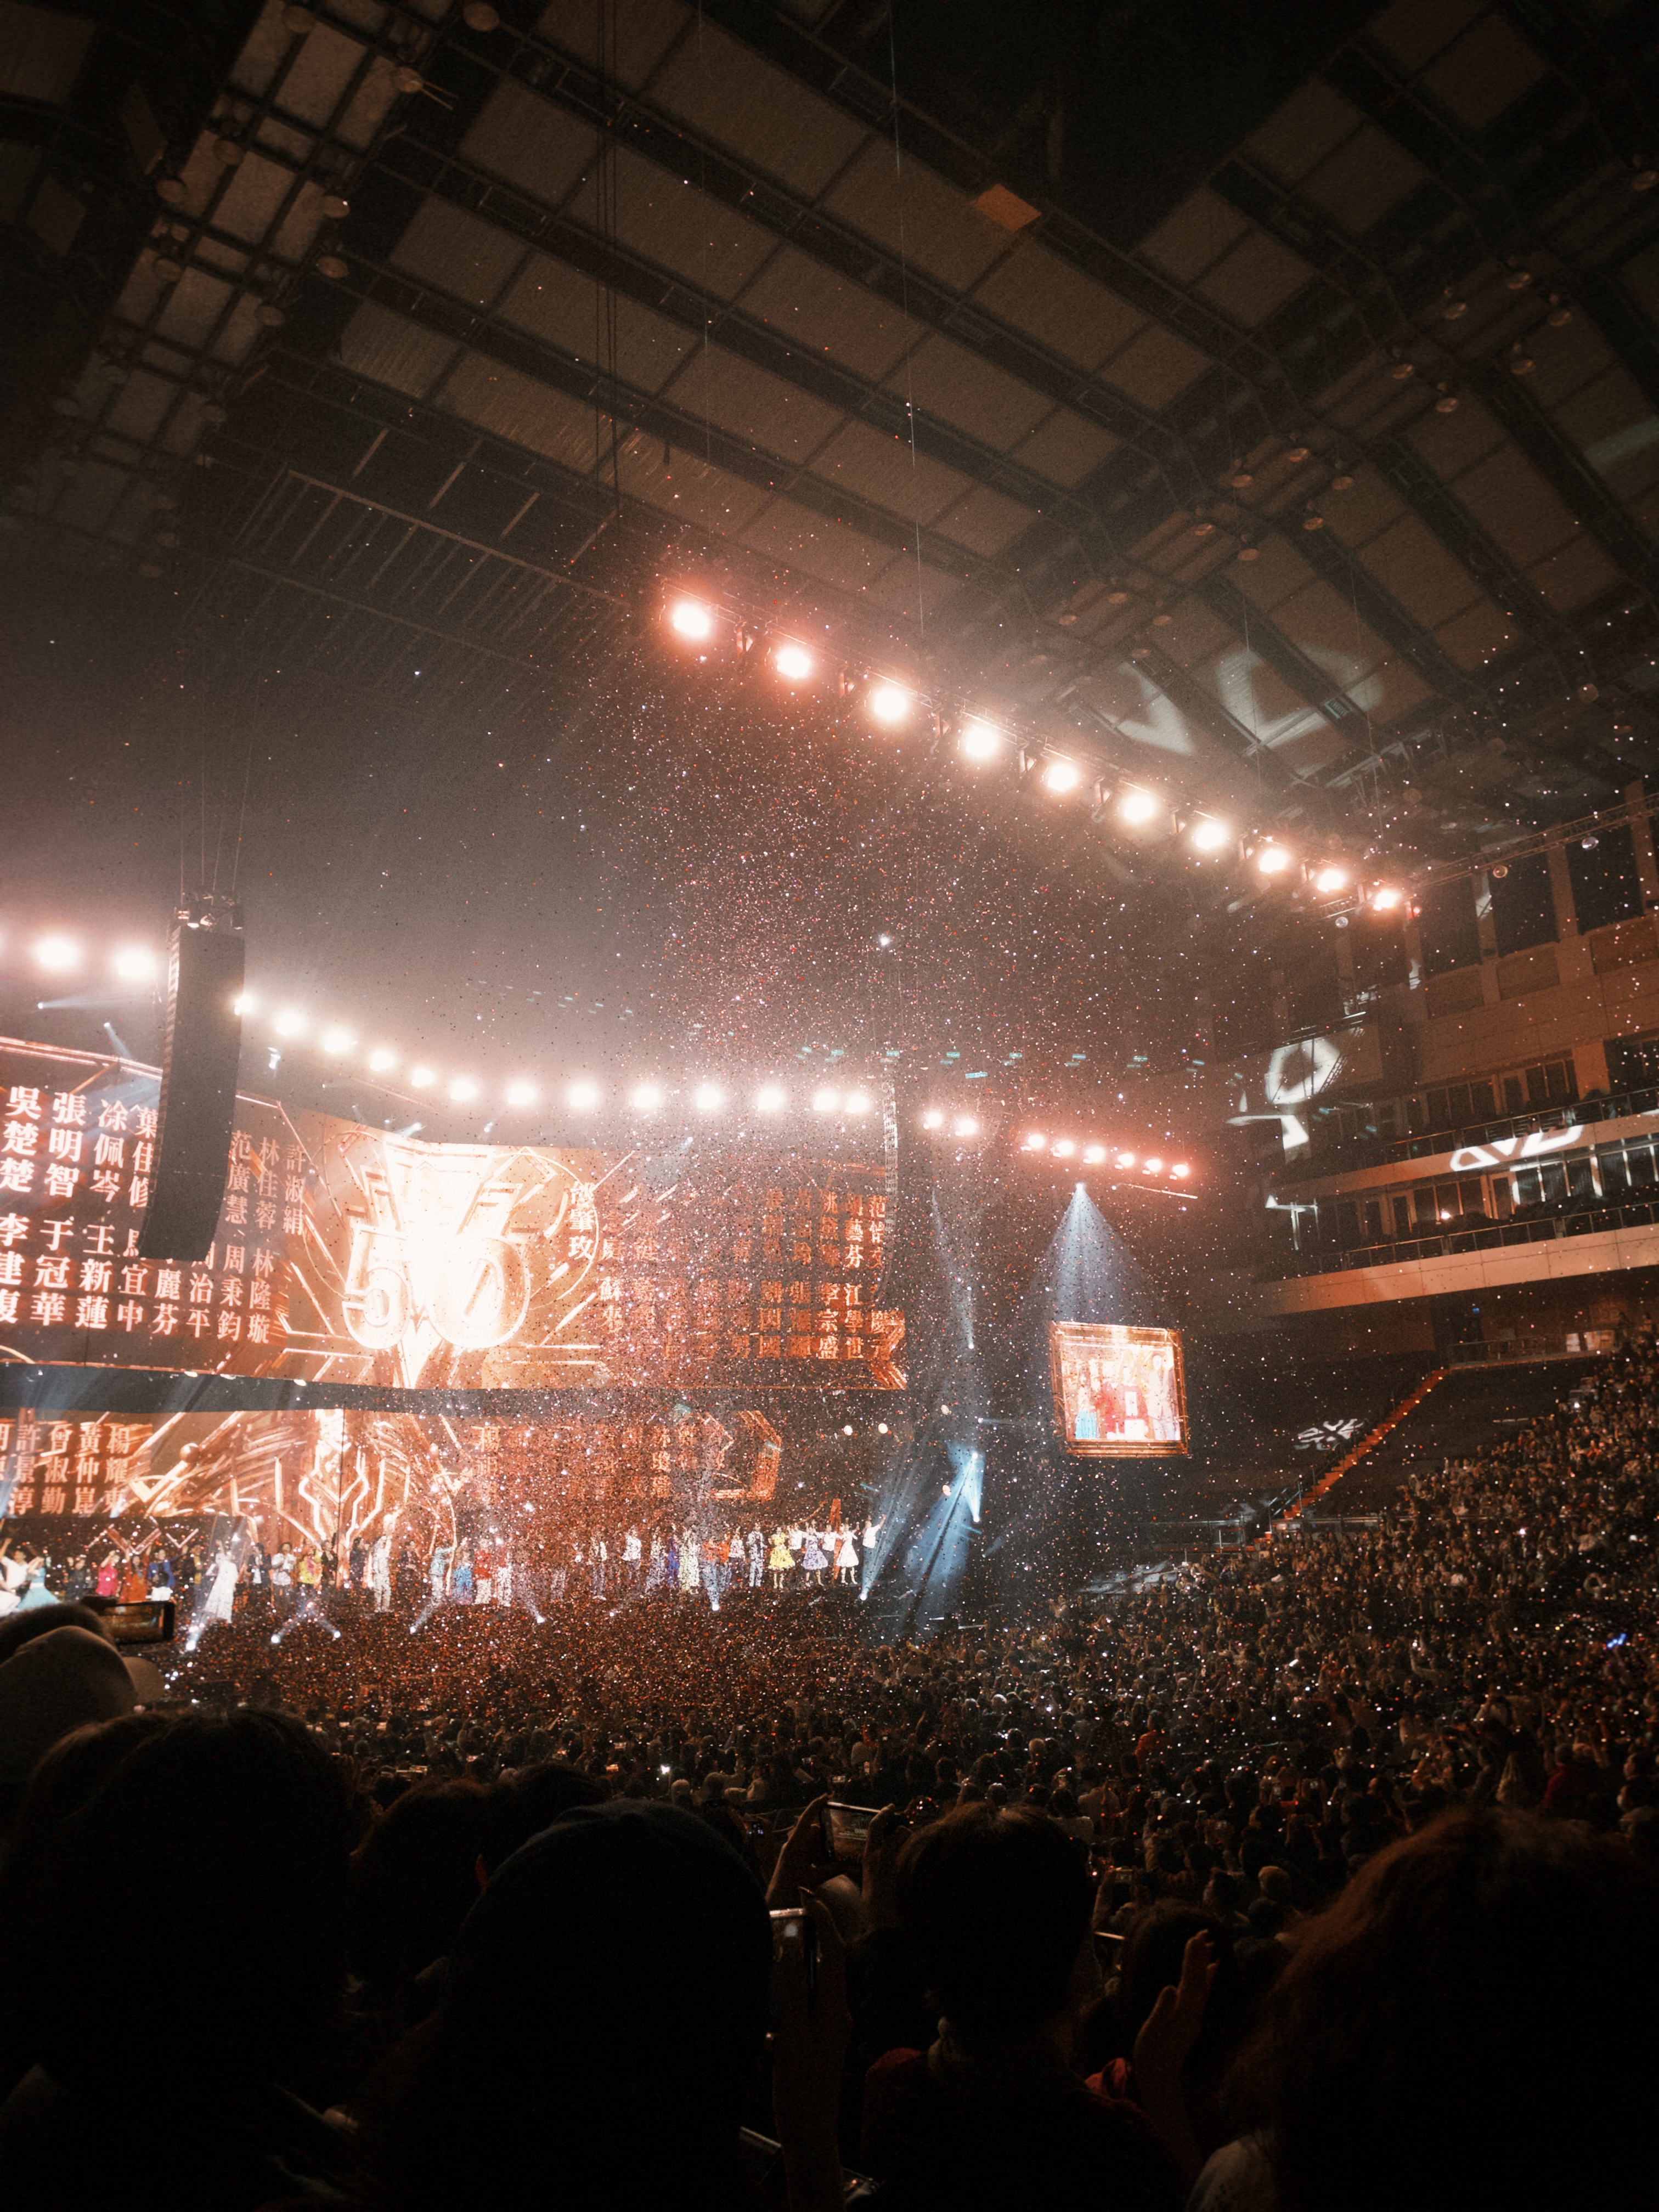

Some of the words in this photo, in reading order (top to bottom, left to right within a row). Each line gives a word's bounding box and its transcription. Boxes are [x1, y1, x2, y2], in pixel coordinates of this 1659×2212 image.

[0, 1086, 42, 1193] 吳楚楚
[44, 1092, 87, 1198] 張明智
[128, 1107, 159, 1207] 葉佳修
[225, 1130, 253, 1224] 范廣慧
[254, 1137, 280, 1230] 林佳蓉
[283, 1144, 306, 1235] 許淑絹
[30, 1220, 74, 1326] 于冠華
[75, 1224, 115, 1329] 王新蓮
[152, 1268, 182, 1335] 麗芬
[186, 1241, 216, 1338] 治平
[217, 1244, 245, 1341] 周秉鈞
[247, 1247, 274, 1344] 林隆璇
[9, 1424, 41, 1515] 許景淳
